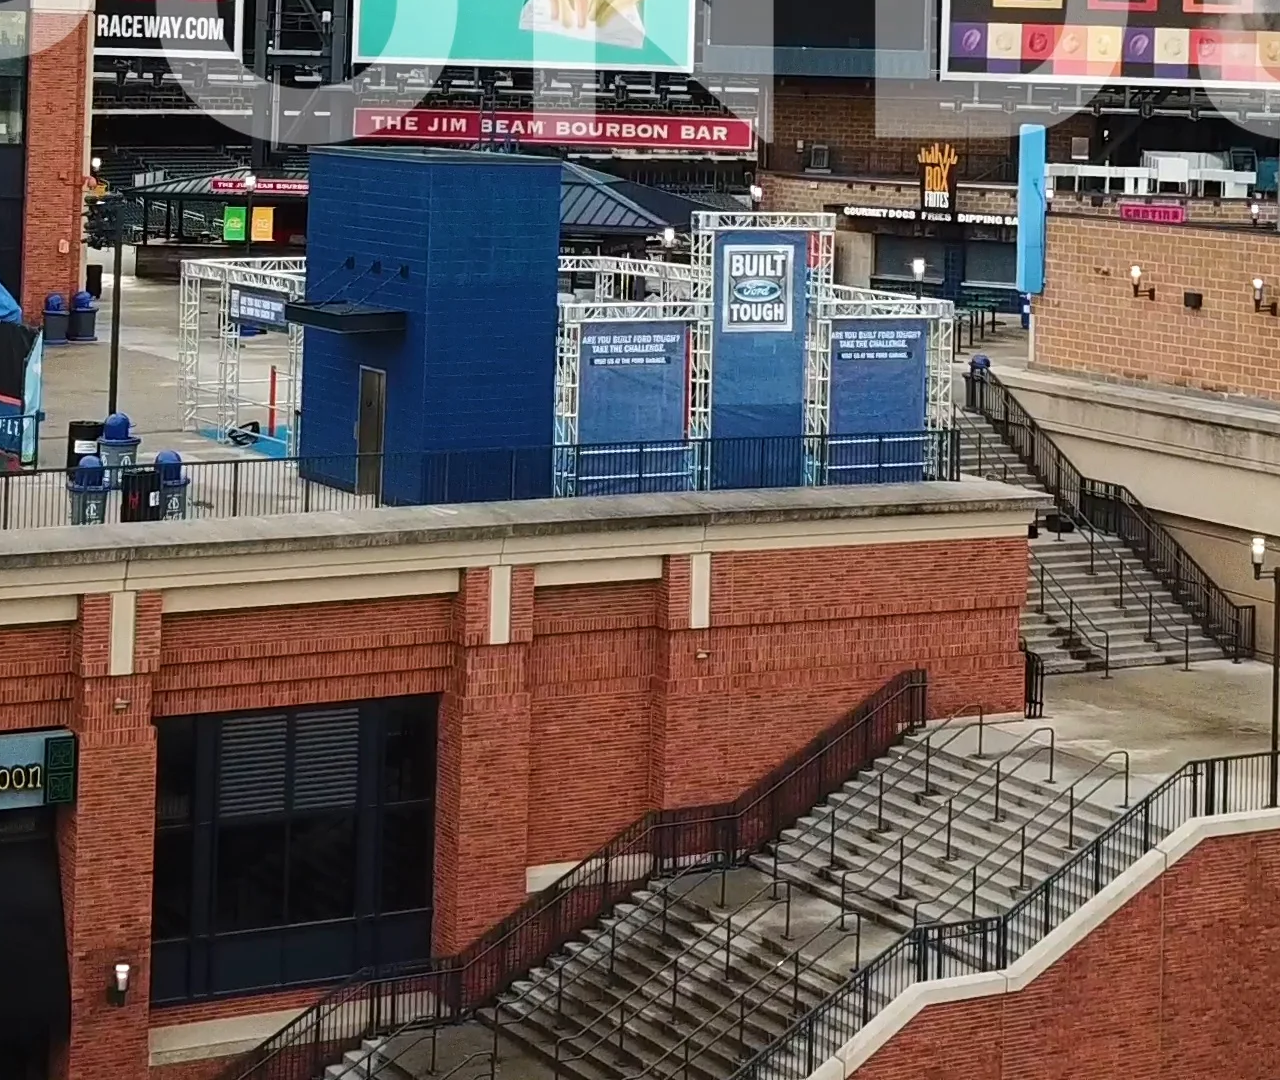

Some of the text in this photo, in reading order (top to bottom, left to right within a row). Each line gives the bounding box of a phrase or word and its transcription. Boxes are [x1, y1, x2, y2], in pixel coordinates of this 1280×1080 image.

[97, 14, 224, 40] RACEWAY.COM
[371, 116, 727, 140] THE JIM BEAM BOURBON BAR
[925, 164, 949, 191] BOX
[843, 207, 888, 218] GOURMET
[888, 209, 916, 219] DOGS
[957, 214, 1002, 224] DIPPING
[731, 254, 786, 276] BUILT
[743, 284, 769, 296] Ford
[730, 303, 784, 321] TOUGH
